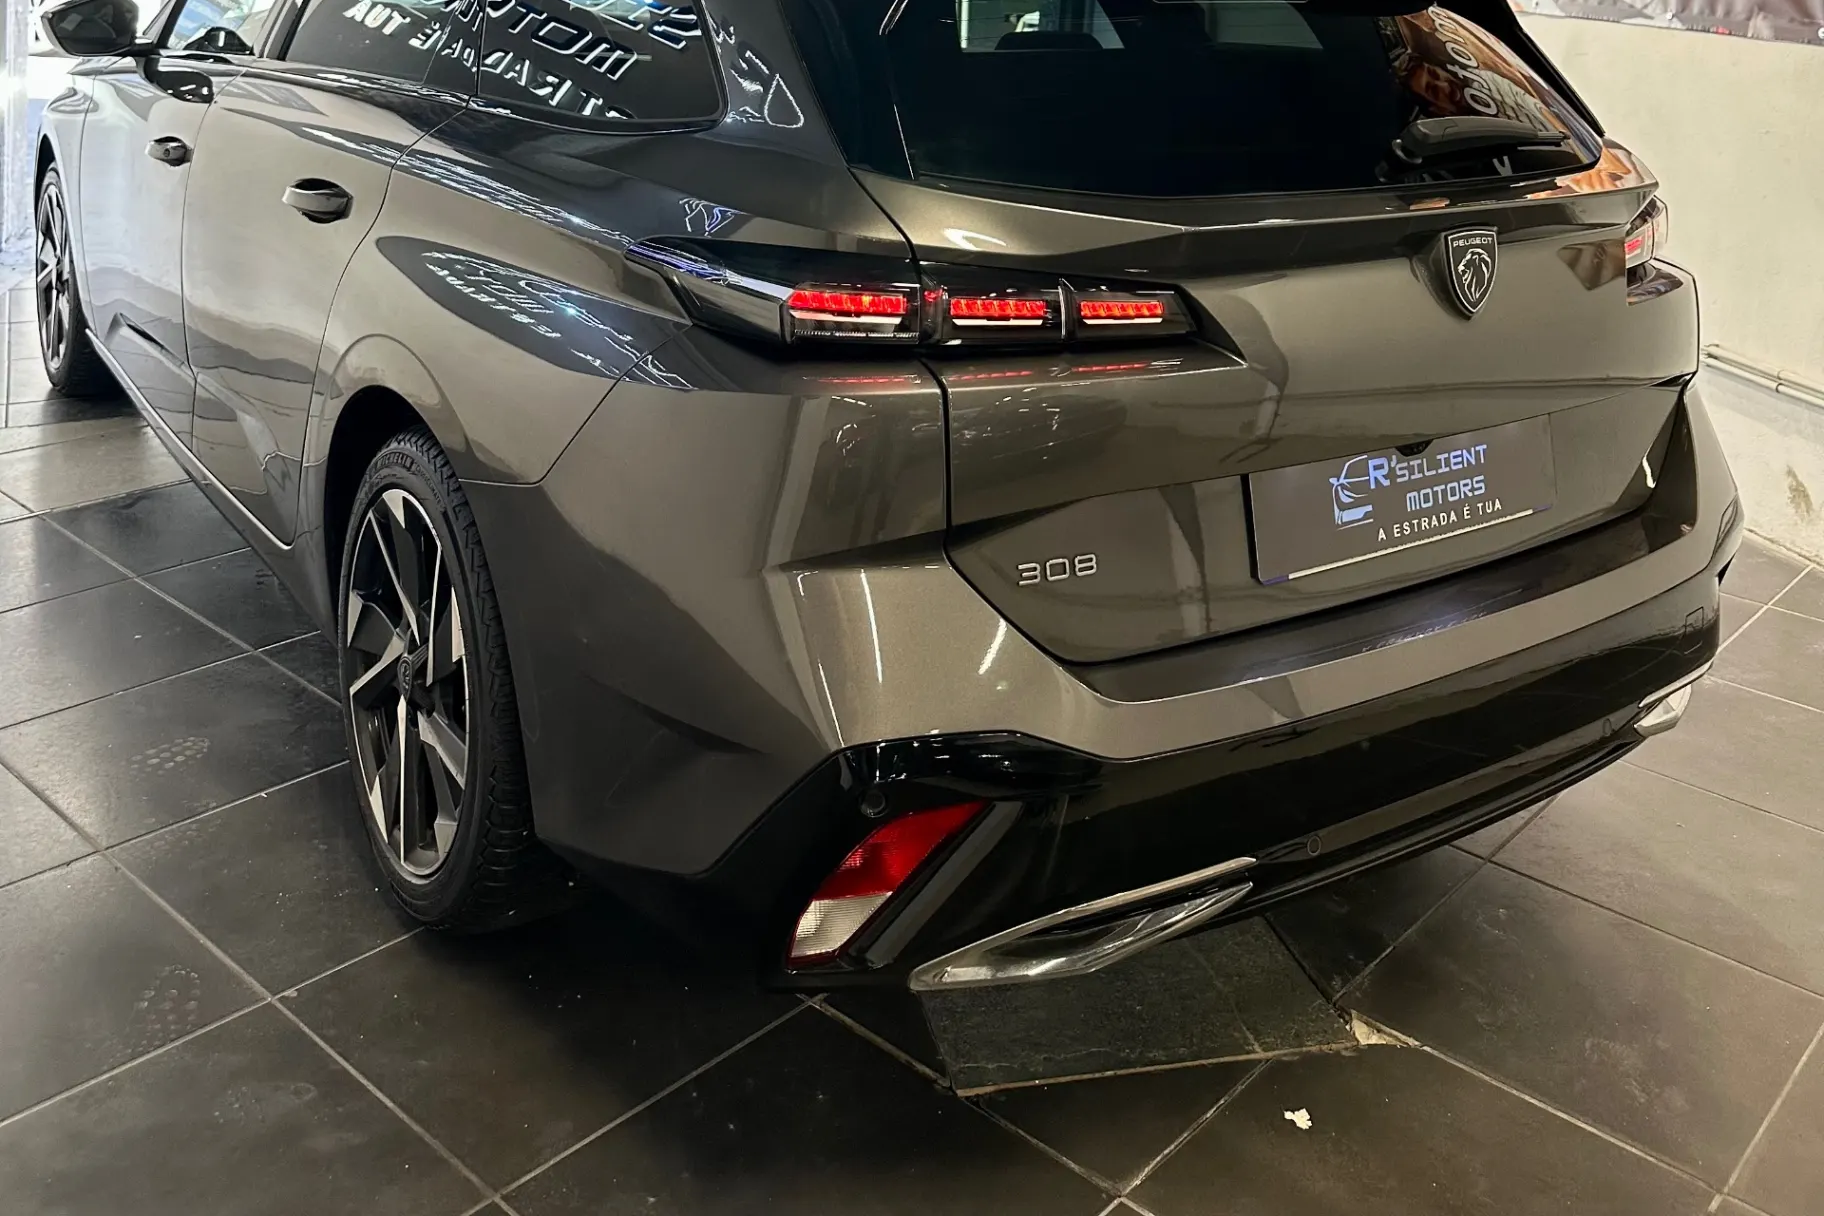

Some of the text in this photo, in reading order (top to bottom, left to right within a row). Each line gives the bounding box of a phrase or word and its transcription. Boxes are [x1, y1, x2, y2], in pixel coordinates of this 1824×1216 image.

[1453, 236, 1493, 248] PEUGEOT
[1406, 474, 1486, 513] MOTORS
[1377, 497, 1503, 542] A ESTRADA É TUA
[1018, 553, 1097, 586] 308
